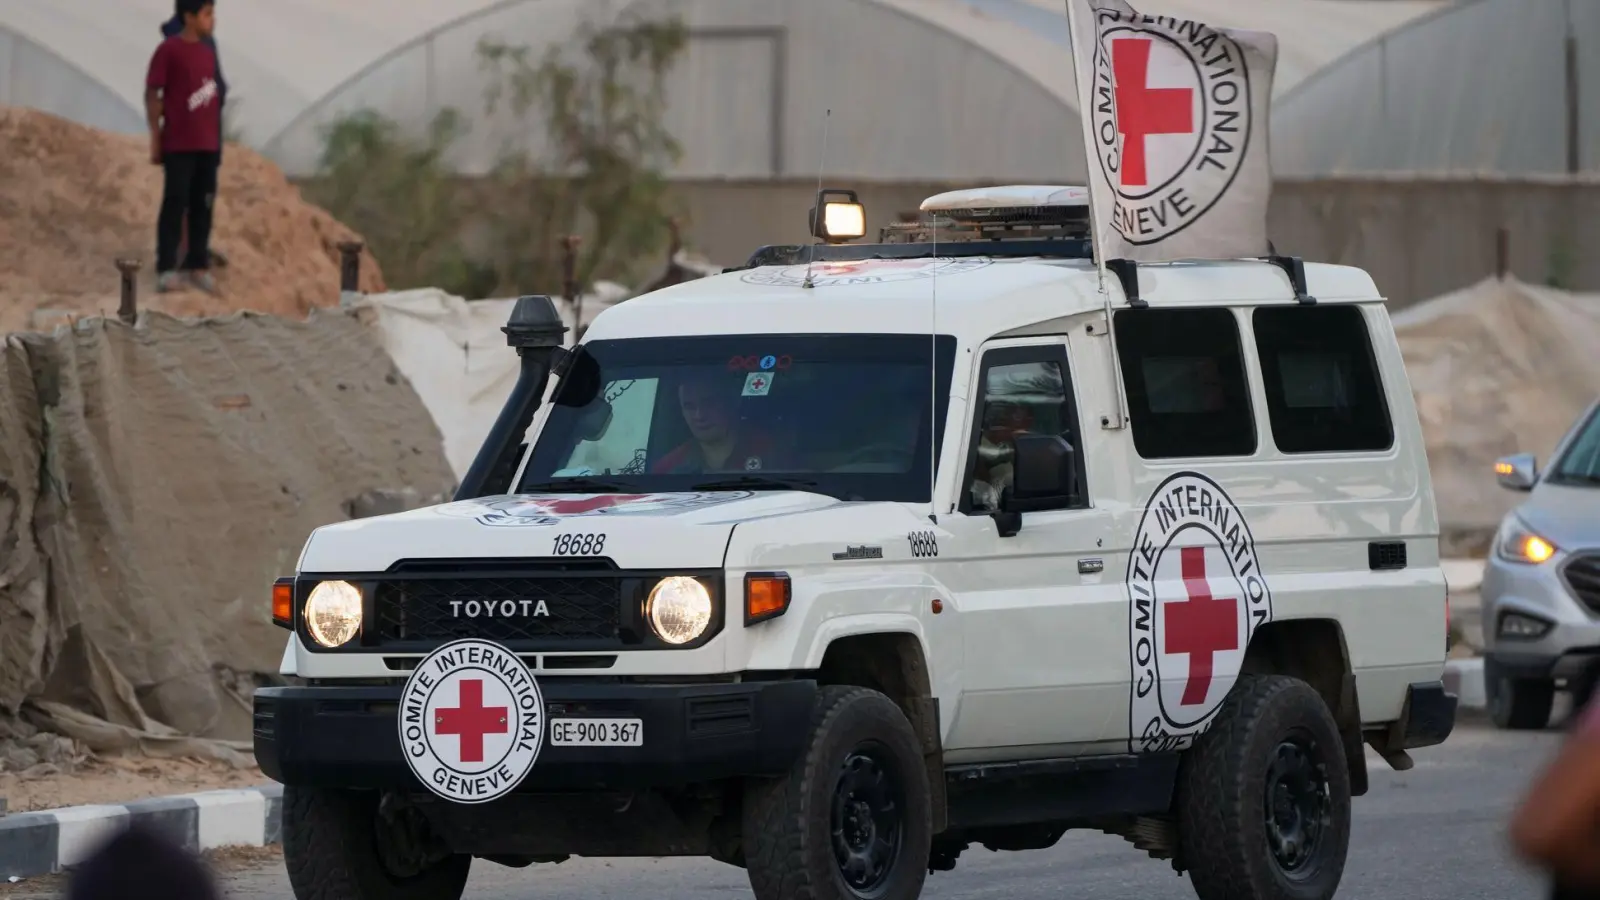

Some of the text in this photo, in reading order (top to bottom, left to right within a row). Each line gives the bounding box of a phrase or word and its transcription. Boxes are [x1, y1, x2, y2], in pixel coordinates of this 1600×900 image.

[1098, 12, 1241, 173] COMIT NNATIONAL
[1113, 188, 1196, 235] ENEVE
[552, 533, 606, 556] 18688
[907, 530, 938, 558] 18688
[1135, 485, 1268, 699] COMITE INTERNATION
[450, 600, 550, 618] TOYOTA
[405, 647, 538, 758] COMITE INTERNATIONAL
[610, 723, 640, 742] 367
[432, 764, 515, 796] GENEVE
